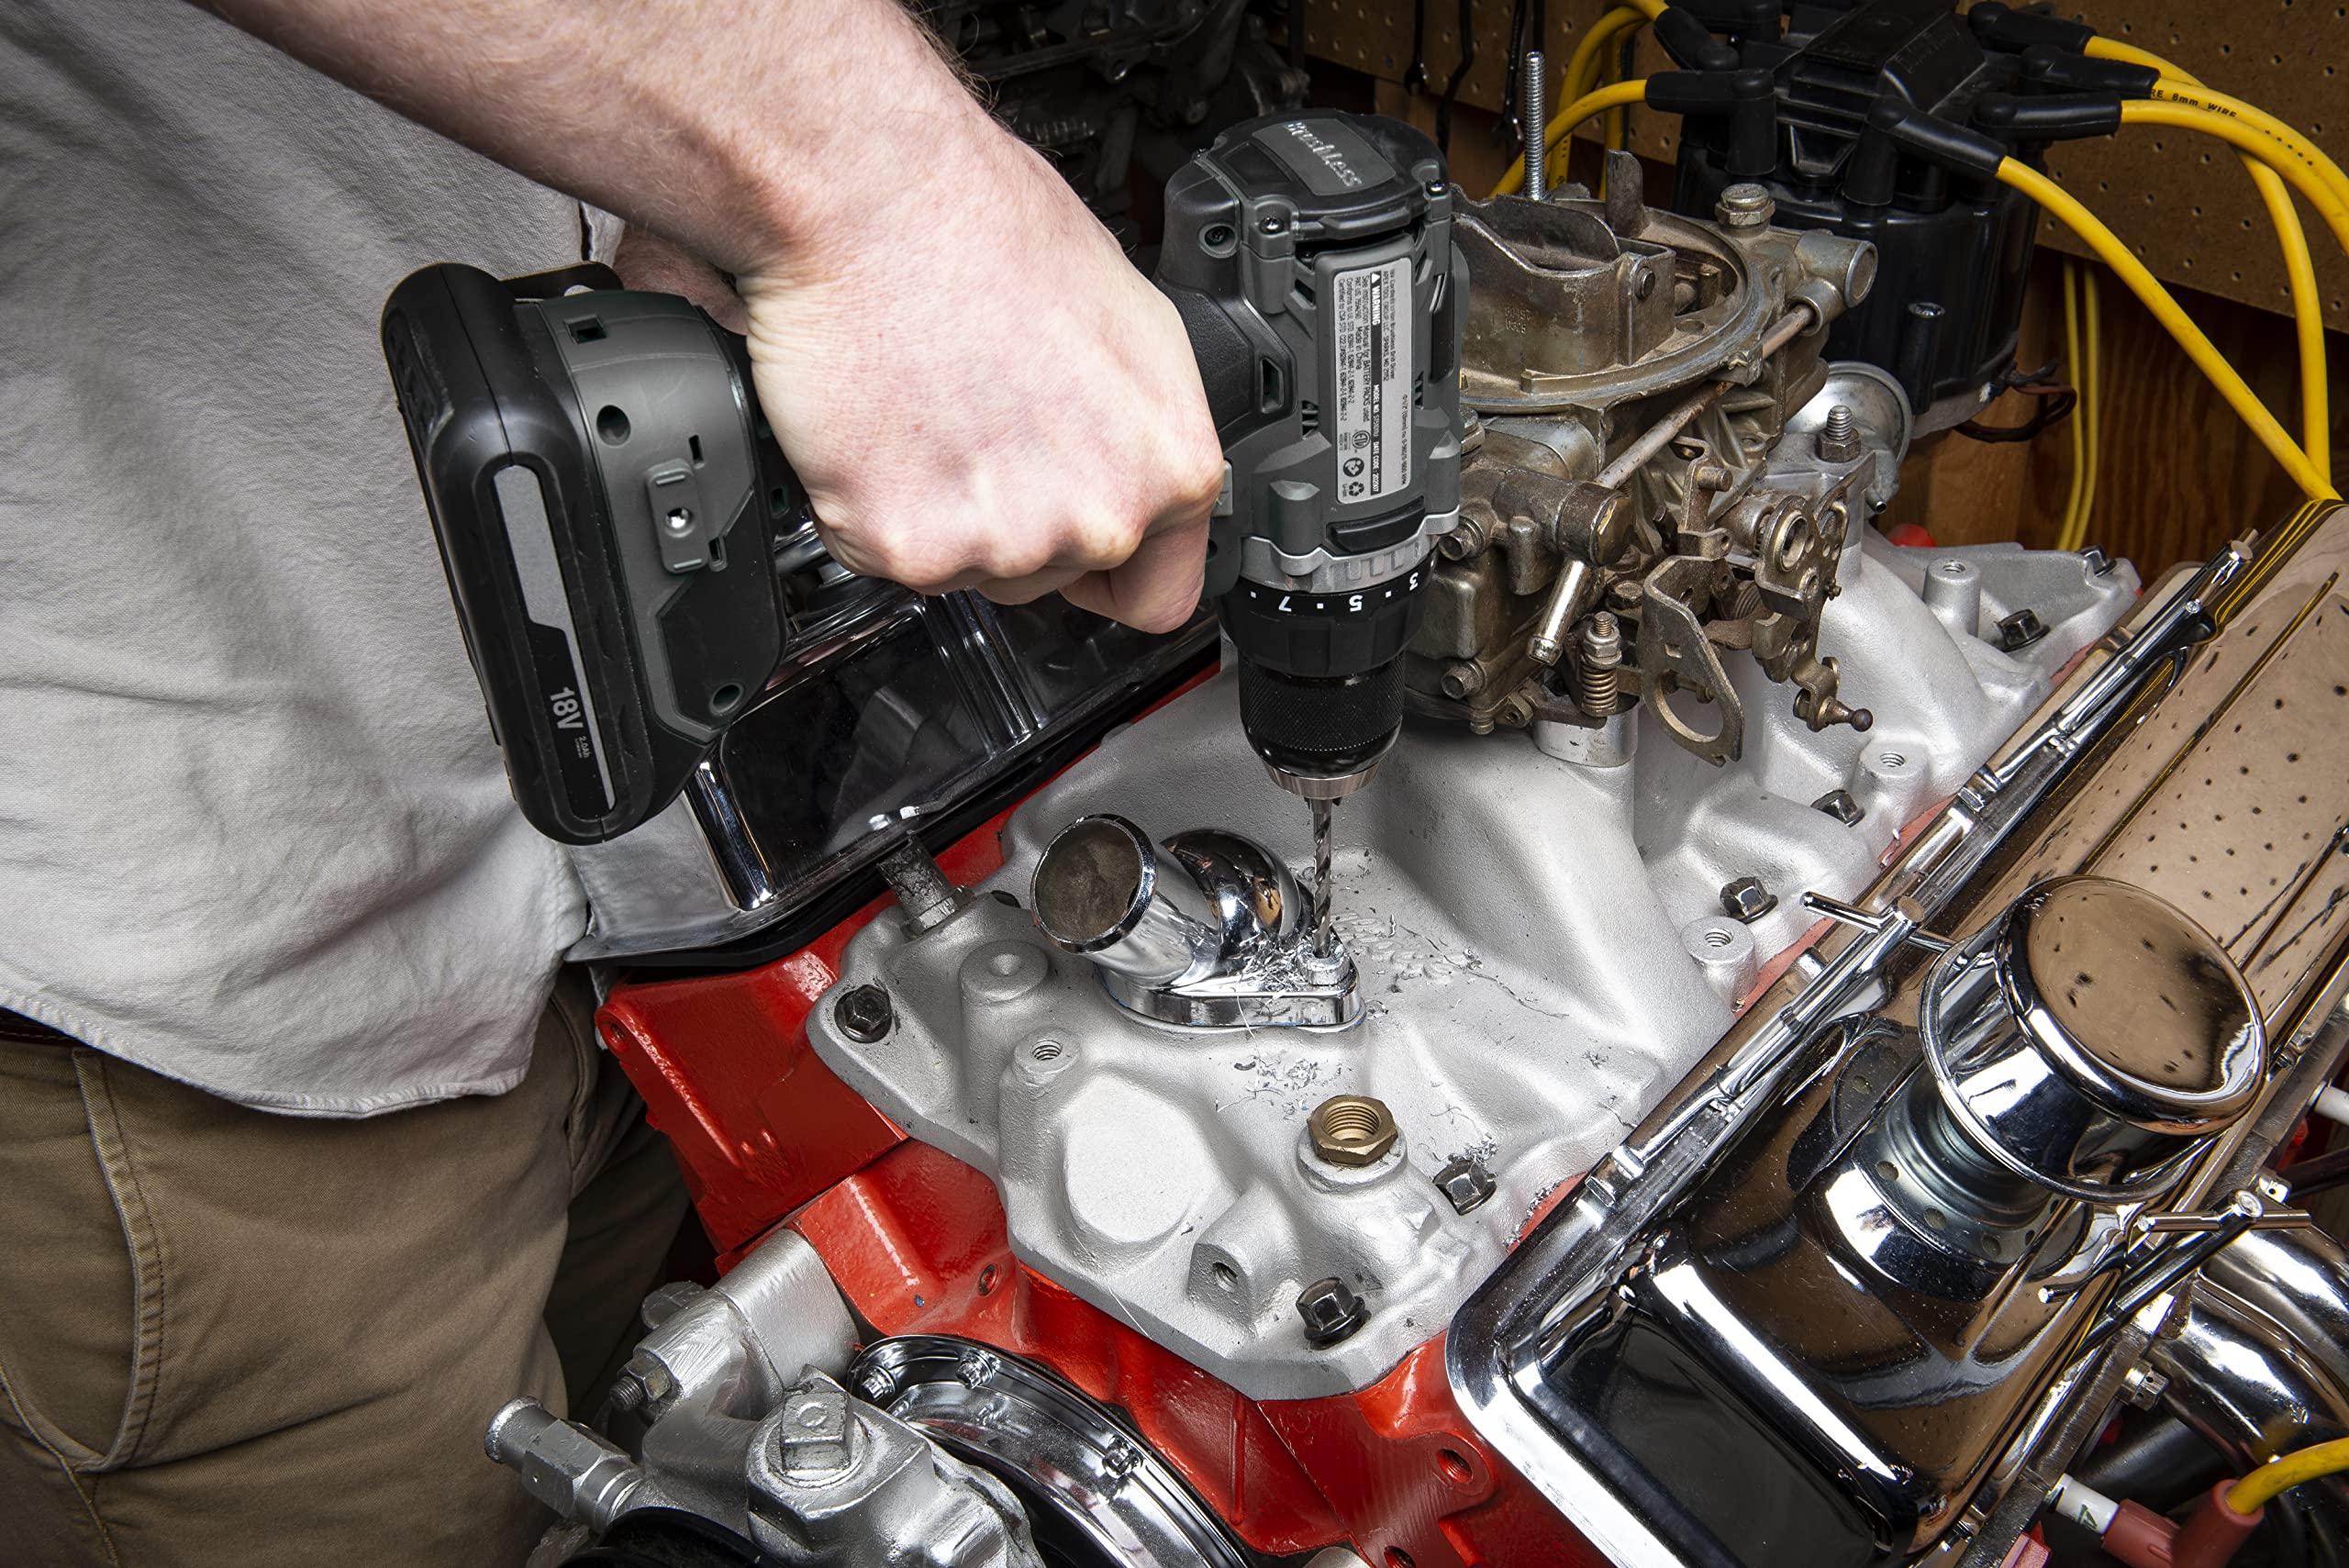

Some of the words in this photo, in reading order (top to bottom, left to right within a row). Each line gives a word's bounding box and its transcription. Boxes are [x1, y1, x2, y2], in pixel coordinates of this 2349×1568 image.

[2173, 94, 2199, 106] 8mm
[2208, 102, 2237, 117] WIRE
[1283, 122, 1363, 187] Brushless
[1362, 275, 1370, 287] See
[1372, 285, 1381, 326] WARNING
[1355, 351, 1364, 370] China
[1383, 358, 1389, 367] MD
[1363, 360, 1371, 385] BATTERY
[1363, 386, 1371, 406] PACKS
[1408, 573, 1419, 591] 3
[1278, 596, 1292, 612] 7
[1349, 595, 1364, 612] 5
[550, 686, 584, 729] 18V
[579, 736, 592, 758] 2.0Ah
